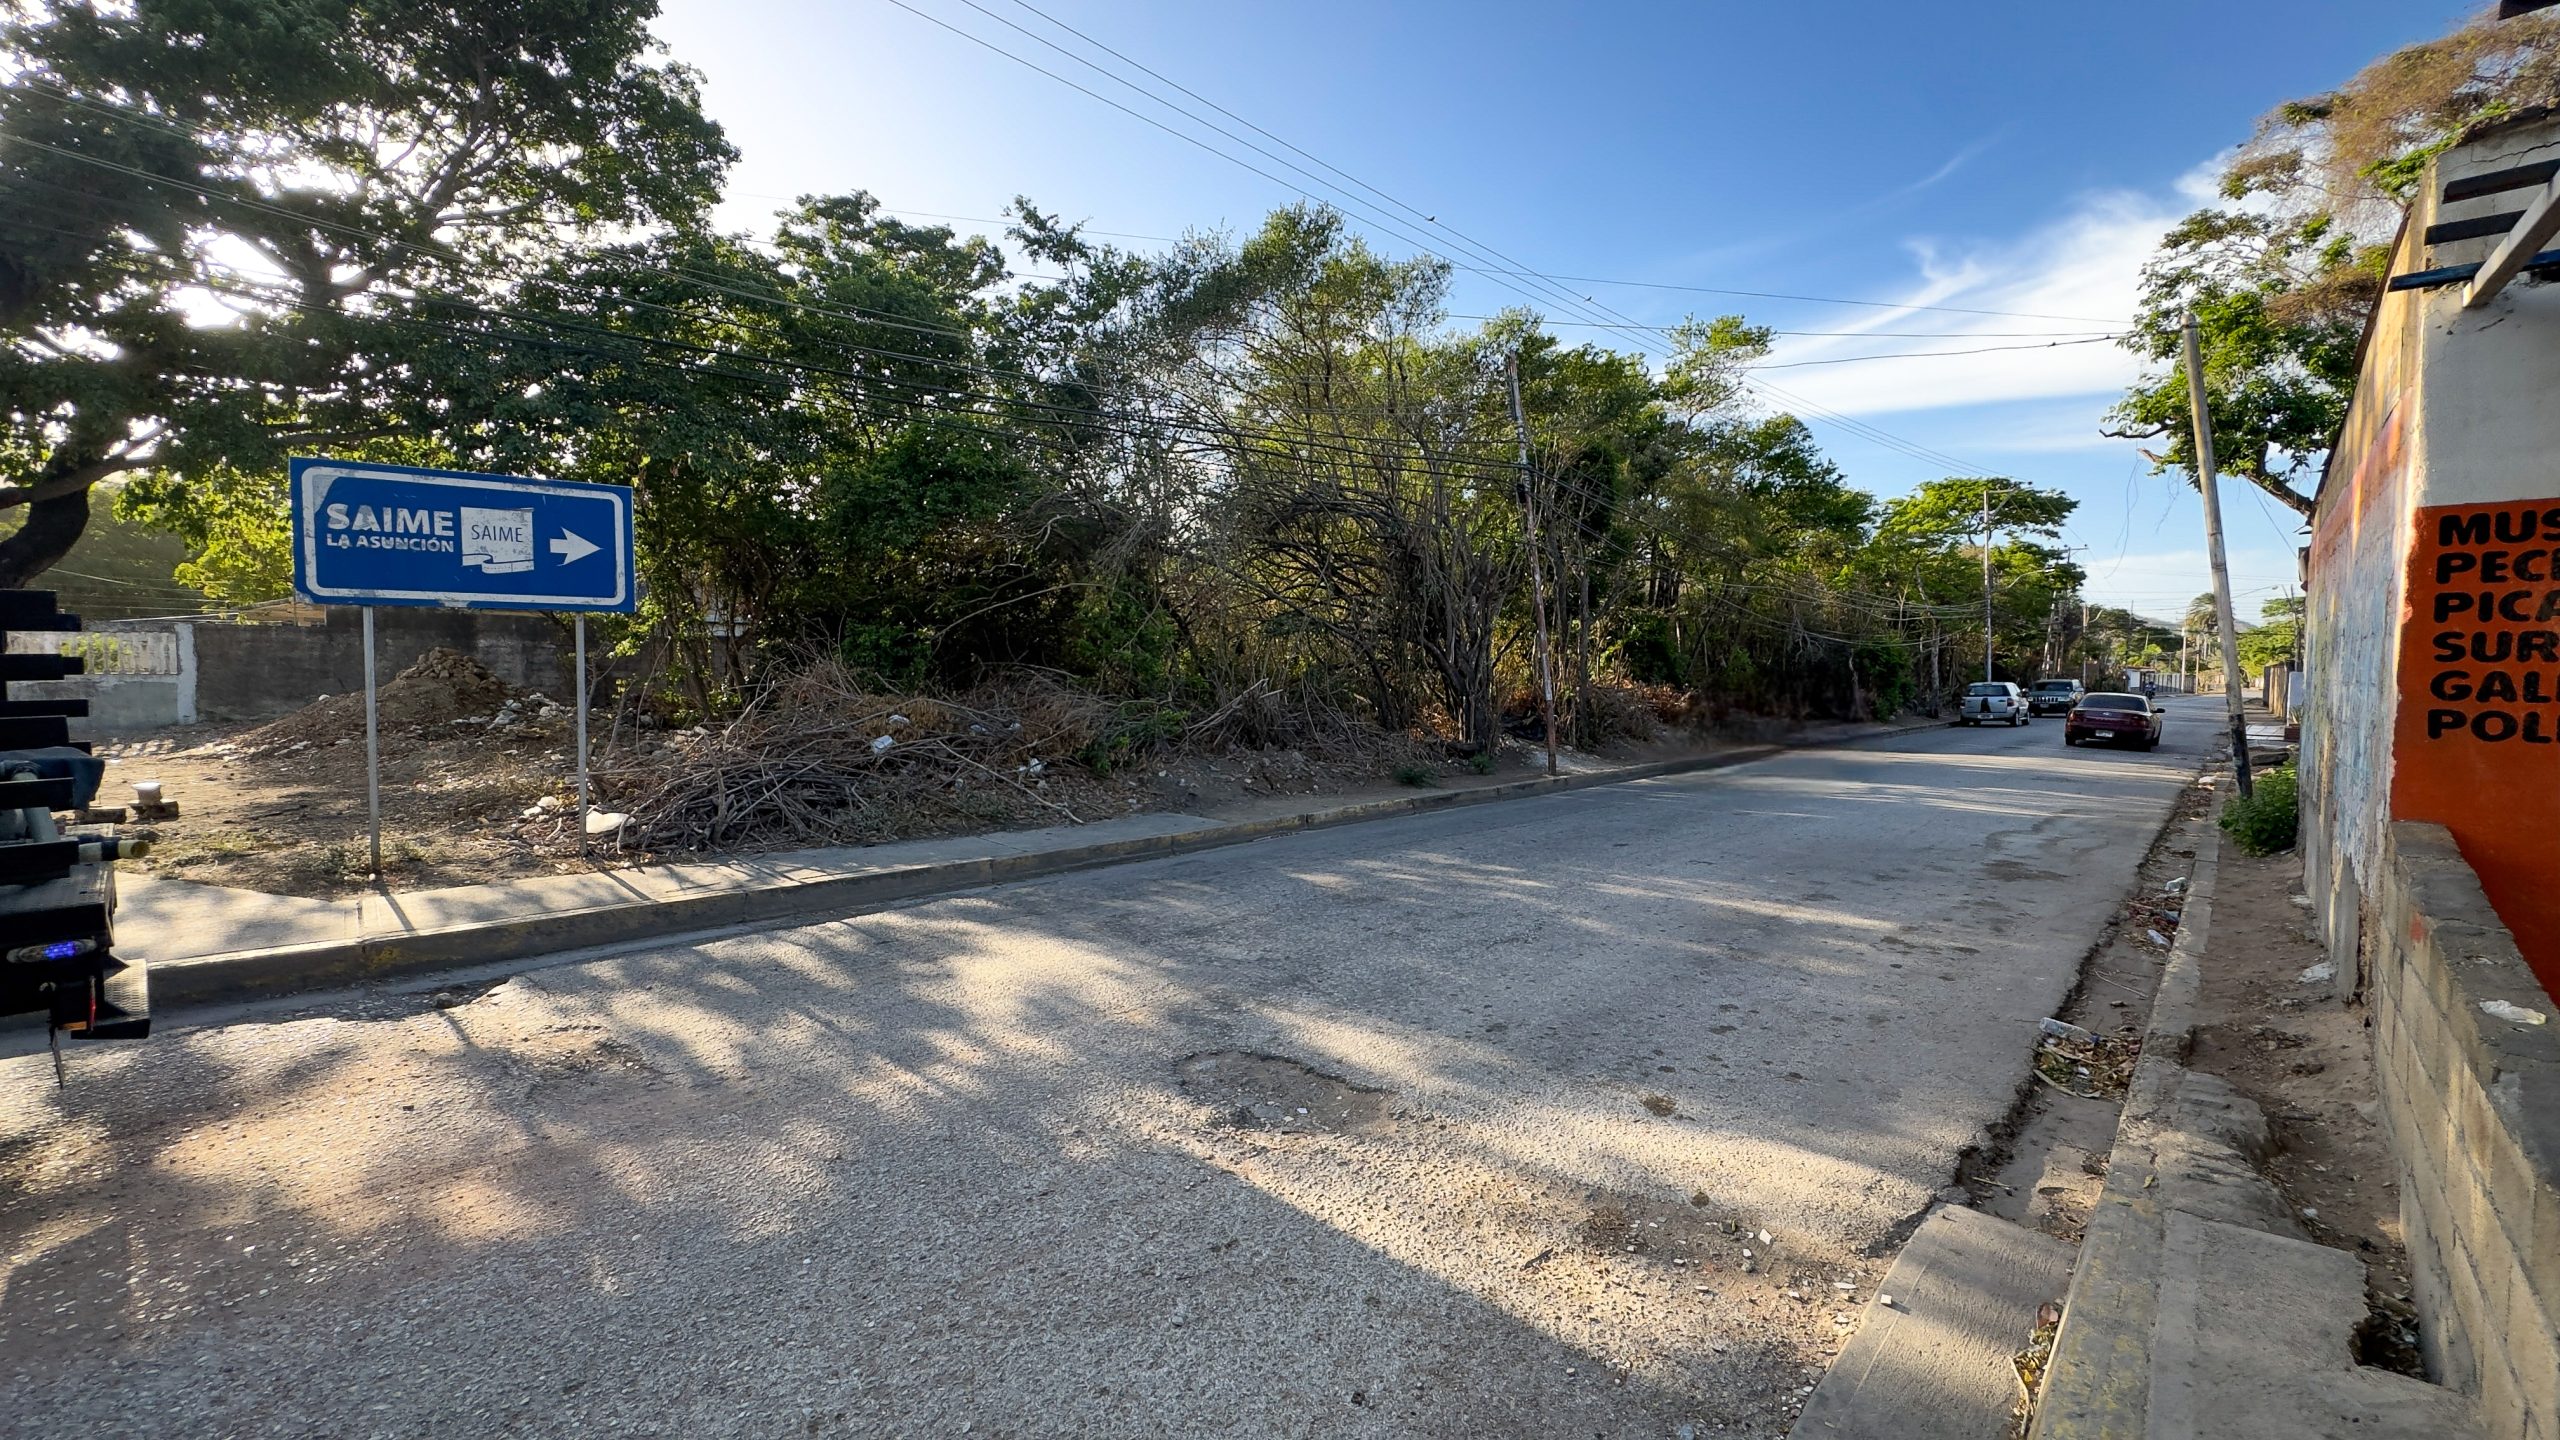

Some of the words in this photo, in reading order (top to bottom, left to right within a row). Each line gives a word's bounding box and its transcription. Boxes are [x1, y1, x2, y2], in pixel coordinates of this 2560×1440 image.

[326, 502, 455, 537] SAIME
[471, 524, 524, 543] SAIME
[326, 533, 351, 549] LA
[356, 535, 454, 553] ASUNCIÓN
[2435, 548, 2560, 584] PEC
[2429, 669, 2560, 704] GAL
[2427, 708, 2560, 743] POL
